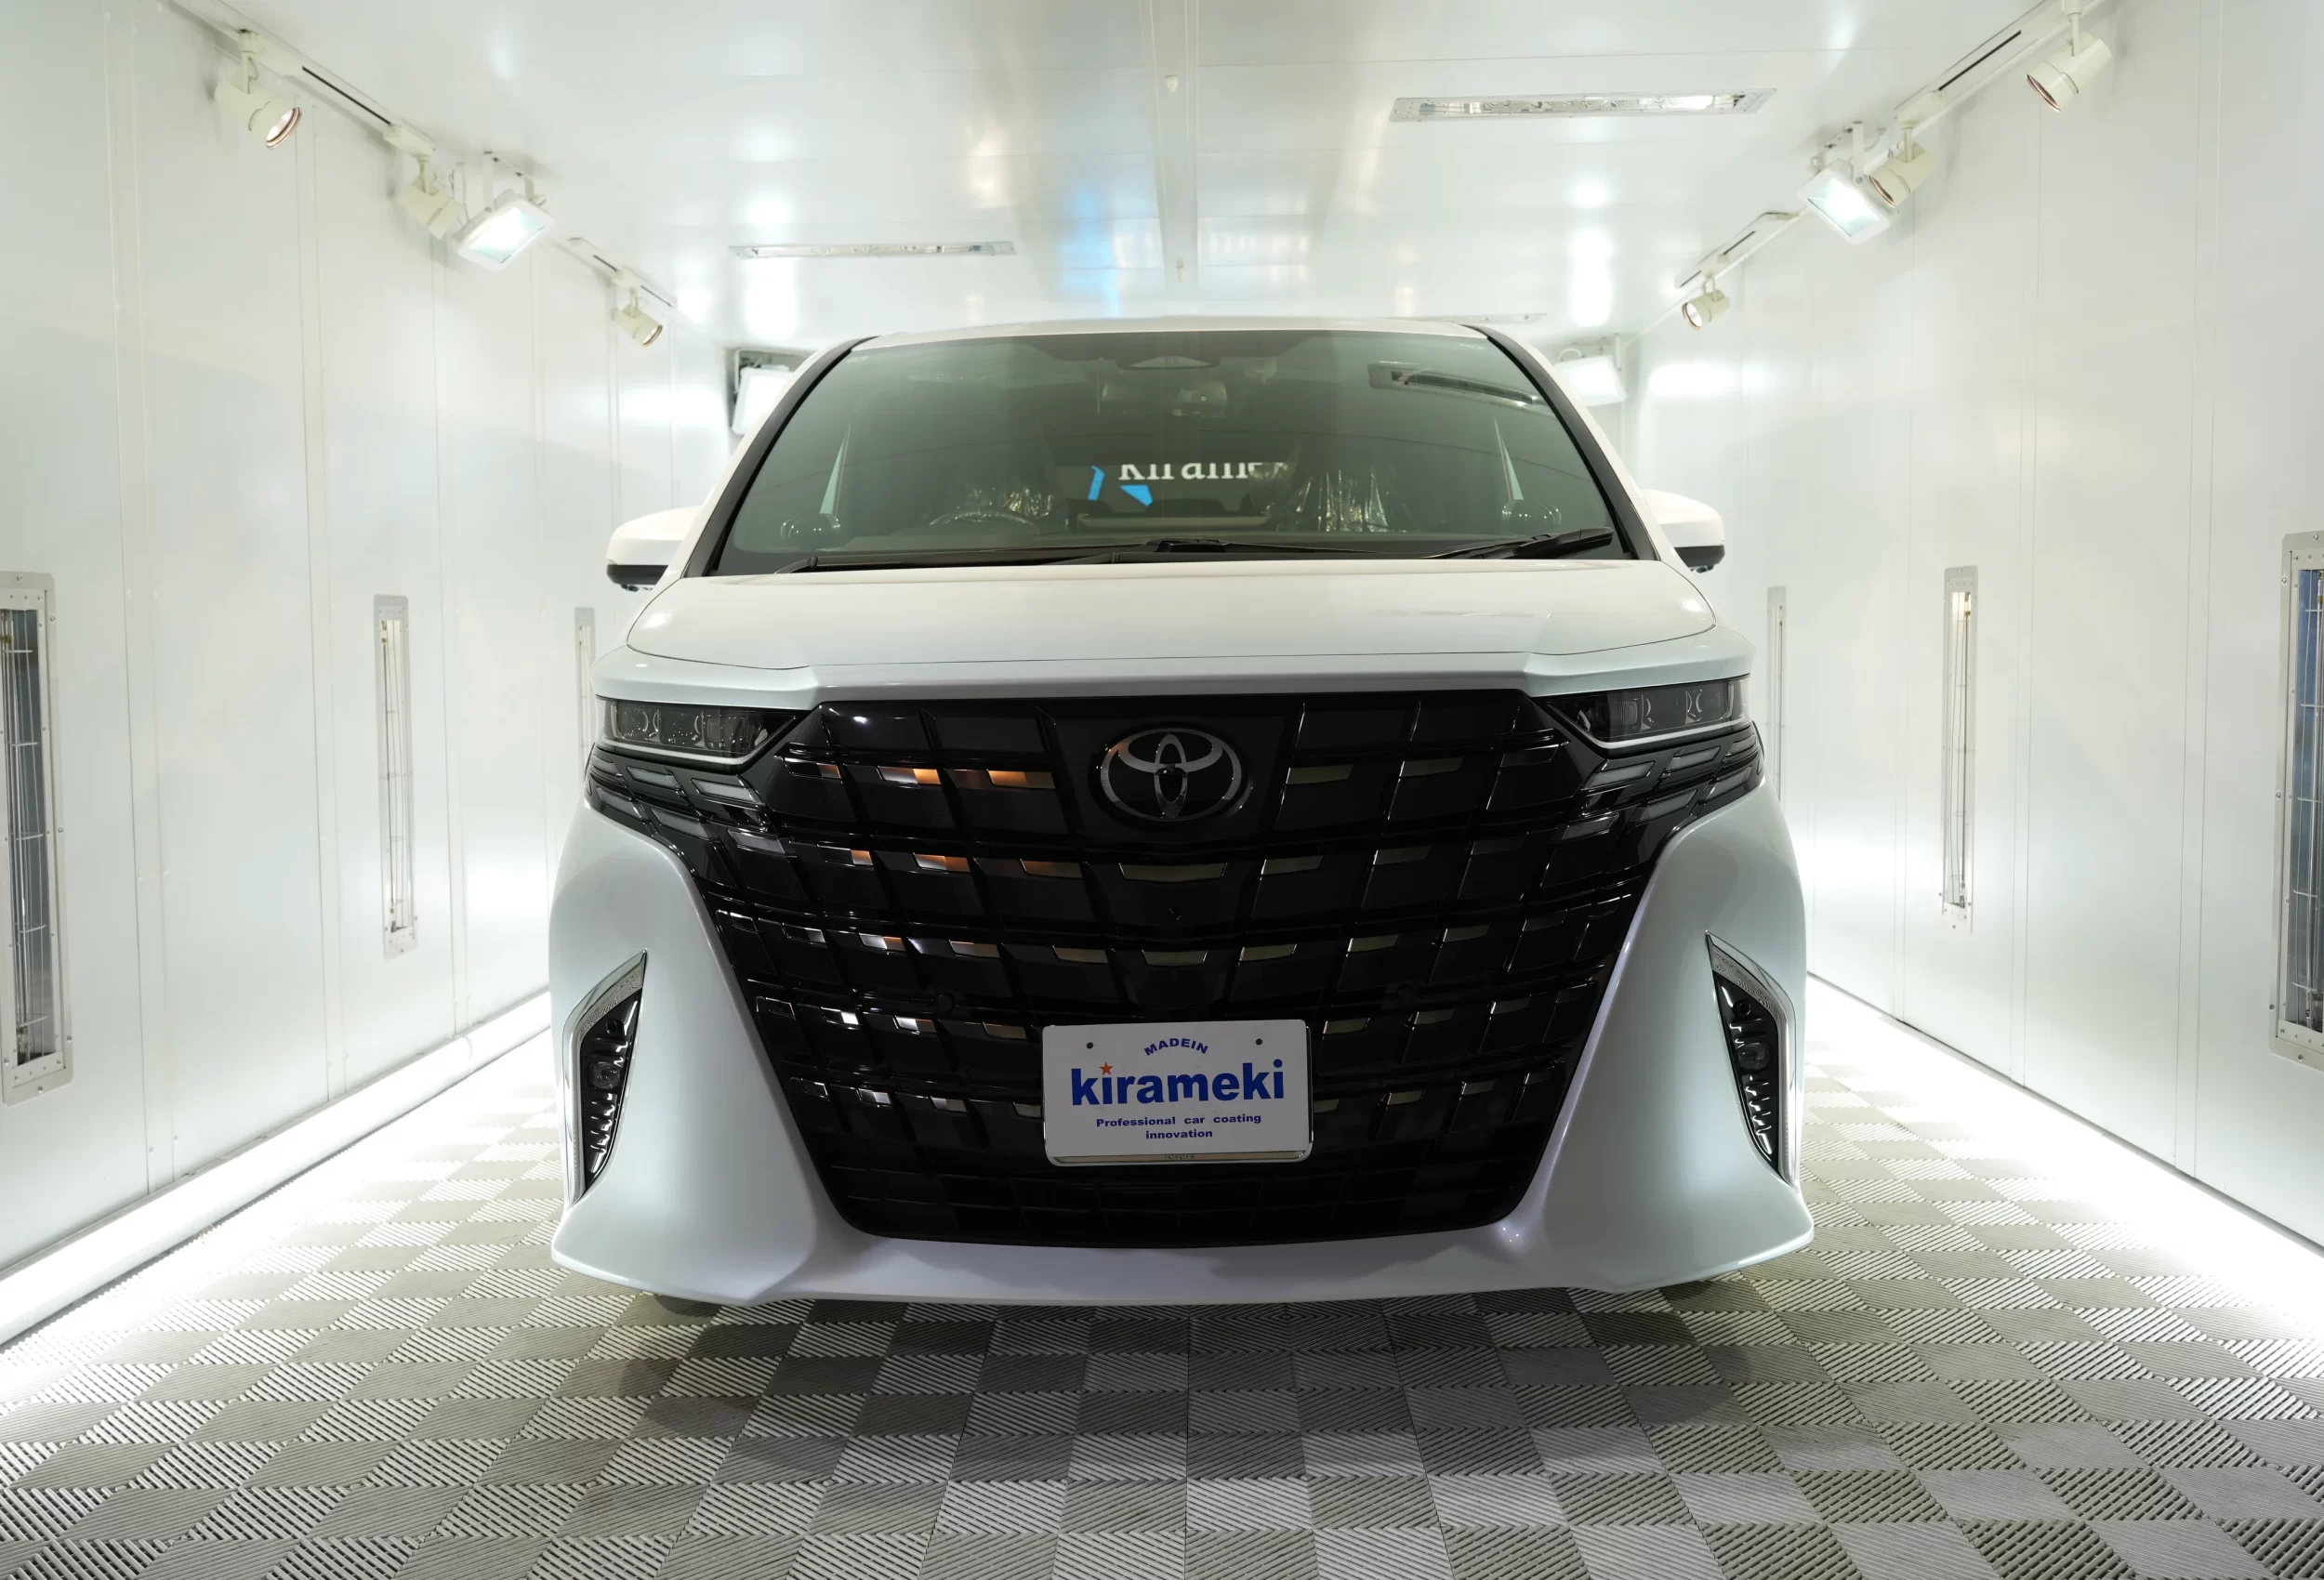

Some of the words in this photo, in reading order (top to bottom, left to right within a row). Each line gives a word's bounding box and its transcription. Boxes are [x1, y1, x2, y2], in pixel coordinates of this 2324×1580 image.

[1071, 1059, 1284, 1106] kirameki
[1096, 1116, 1176, 1127] Professional
[1183, 1116, 1206, 1125] car
[1213, 1113, 1261, 1124] coating
[1145, 1129, 1213, 1139] innovation
